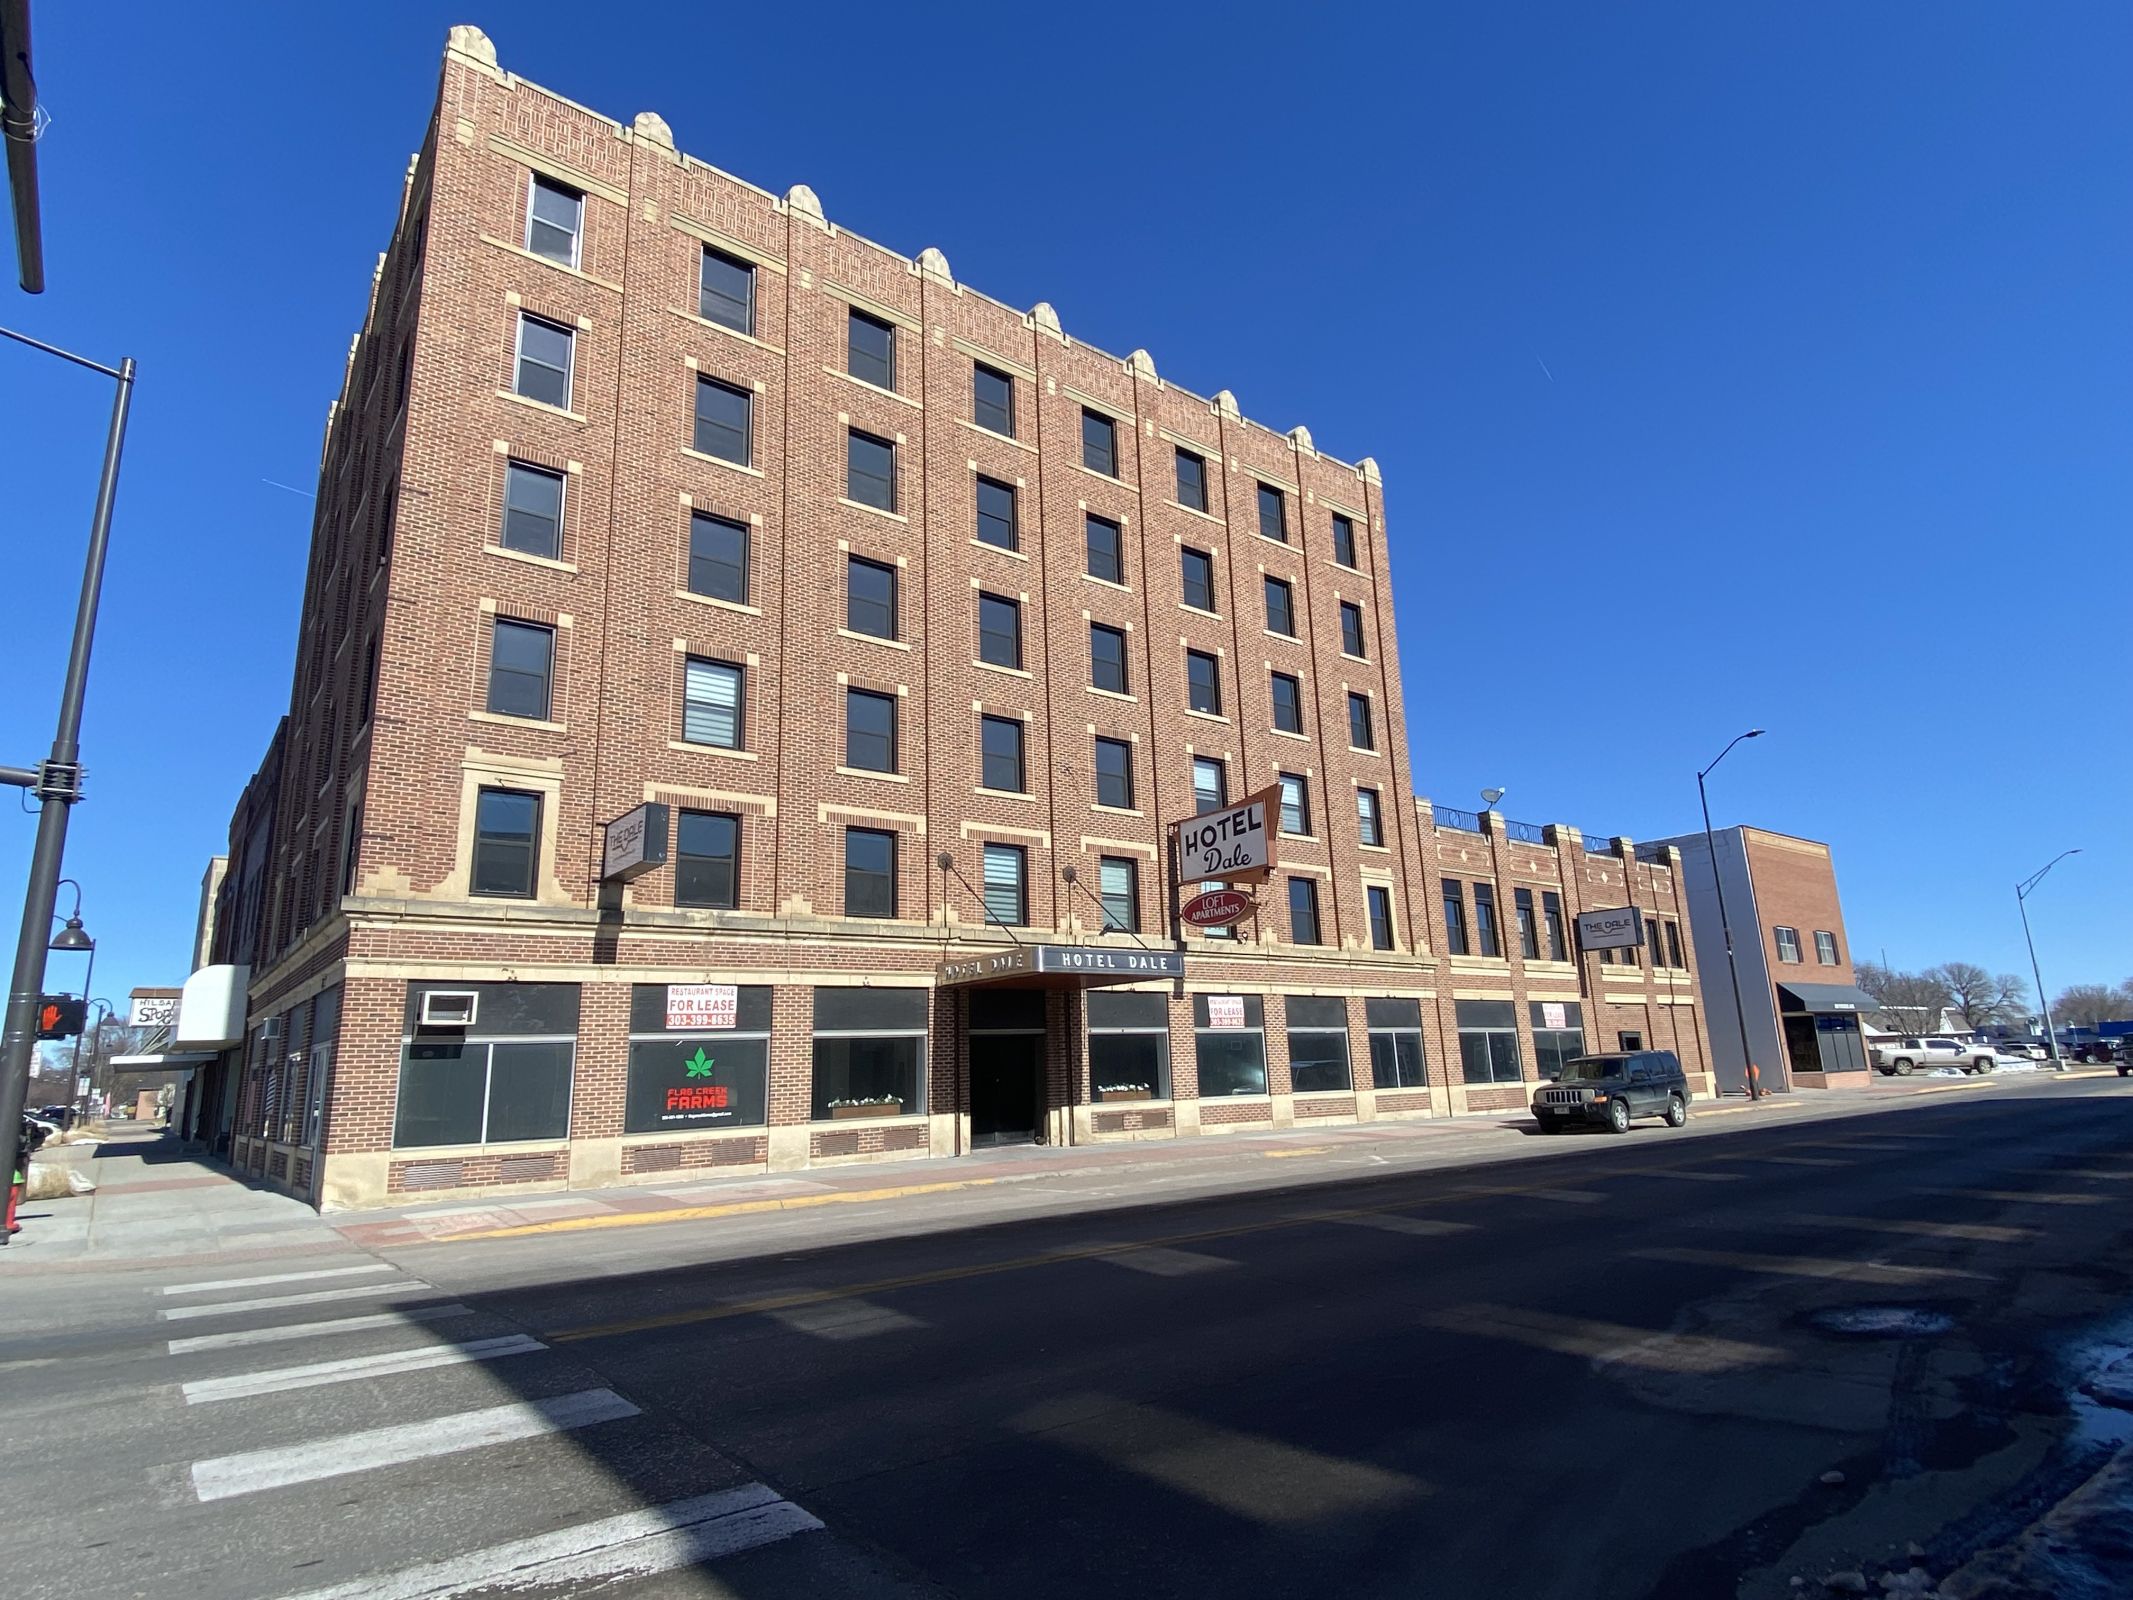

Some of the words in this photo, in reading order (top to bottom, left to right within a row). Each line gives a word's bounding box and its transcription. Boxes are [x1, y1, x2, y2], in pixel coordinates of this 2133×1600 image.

[610, 830, 624, 847] THE
[1185, 807, 1262, 857] HOTEL
[1203, 843, 1253, 874] Dale
[1202, 894, 1226, 910] LOFT
[1191, 903, 1240, 921] APARTMENTS
[1584, 922, 1603, 931] THE
[1604, 918, 1631, 929] DALE
[1062, 953, 1115, 968] HOTEL
[1128, 956, 1168, 970] DALE
[671, 987, 713, 996] RESTAURANT
[715, 987, 735, 996] SPACE
[669, 999, 694, 1011] FOR
[697, 999, 735, 1011] LEASE
[1210, 1007, 1223, 1016] FOR
[1223, 1007, 1243, 1016] LEASE
[667, 1088, 693, 1097] FLAG
[695, 1086, 728, 1096] CREEK
[667, 1095, 728, 1111] FARMS
